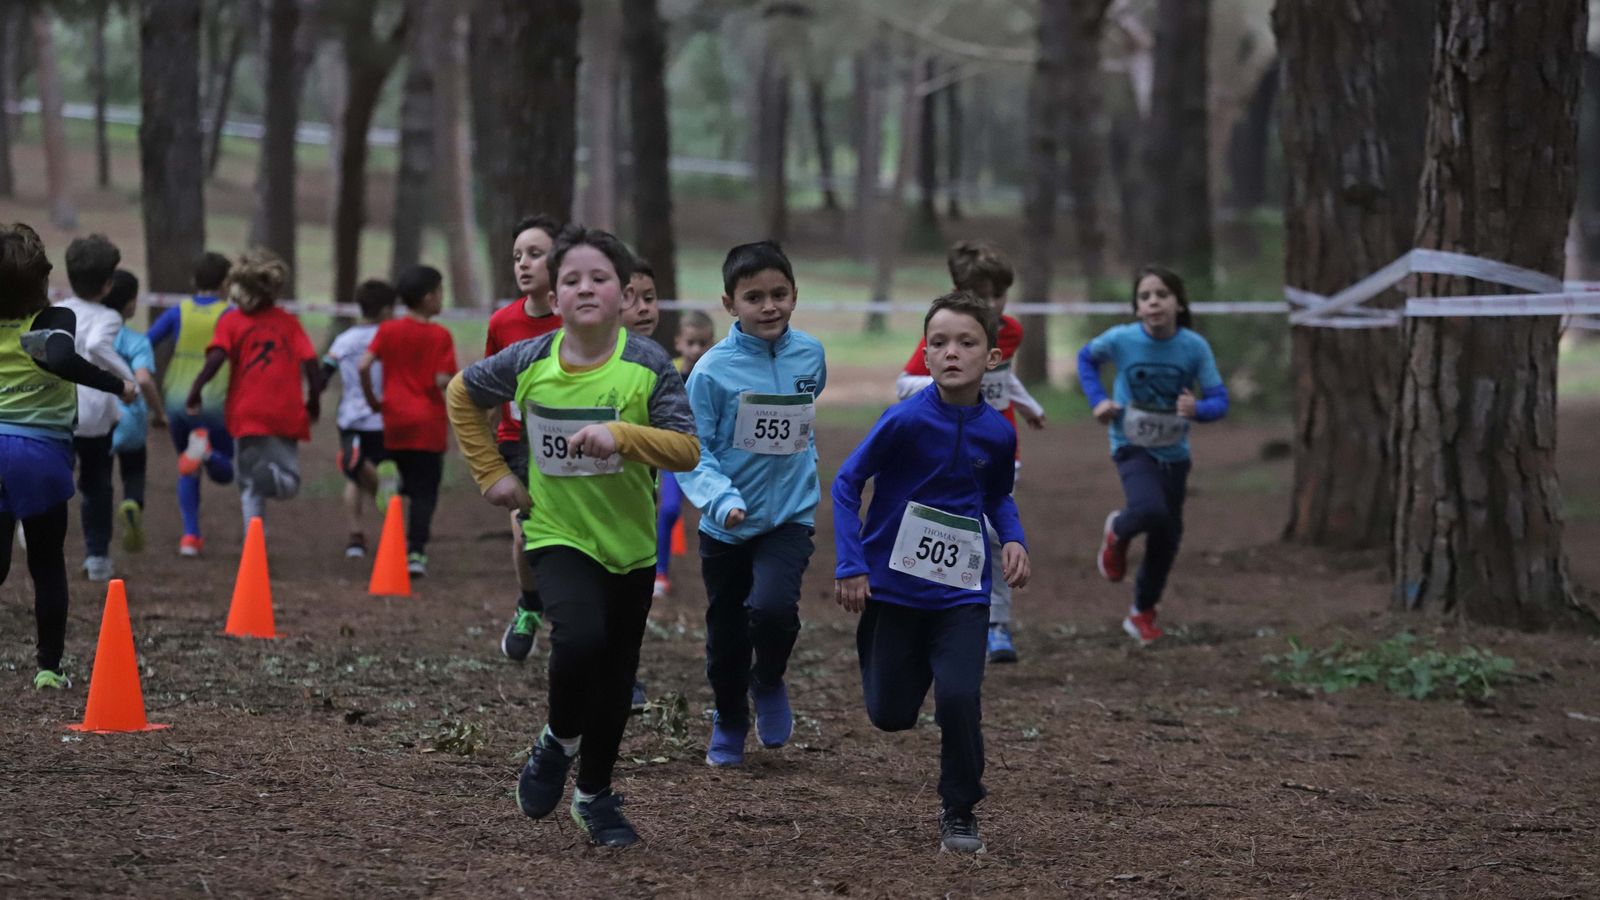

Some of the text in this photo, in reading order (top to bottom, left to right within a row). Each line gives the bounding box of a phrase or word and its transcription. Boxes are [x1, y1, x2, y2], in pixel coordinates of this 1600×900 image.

[754, 418, 791, 440] 553
[923, 526, 957, 542] THOMAS
[915, 536, 959, 568] 503
